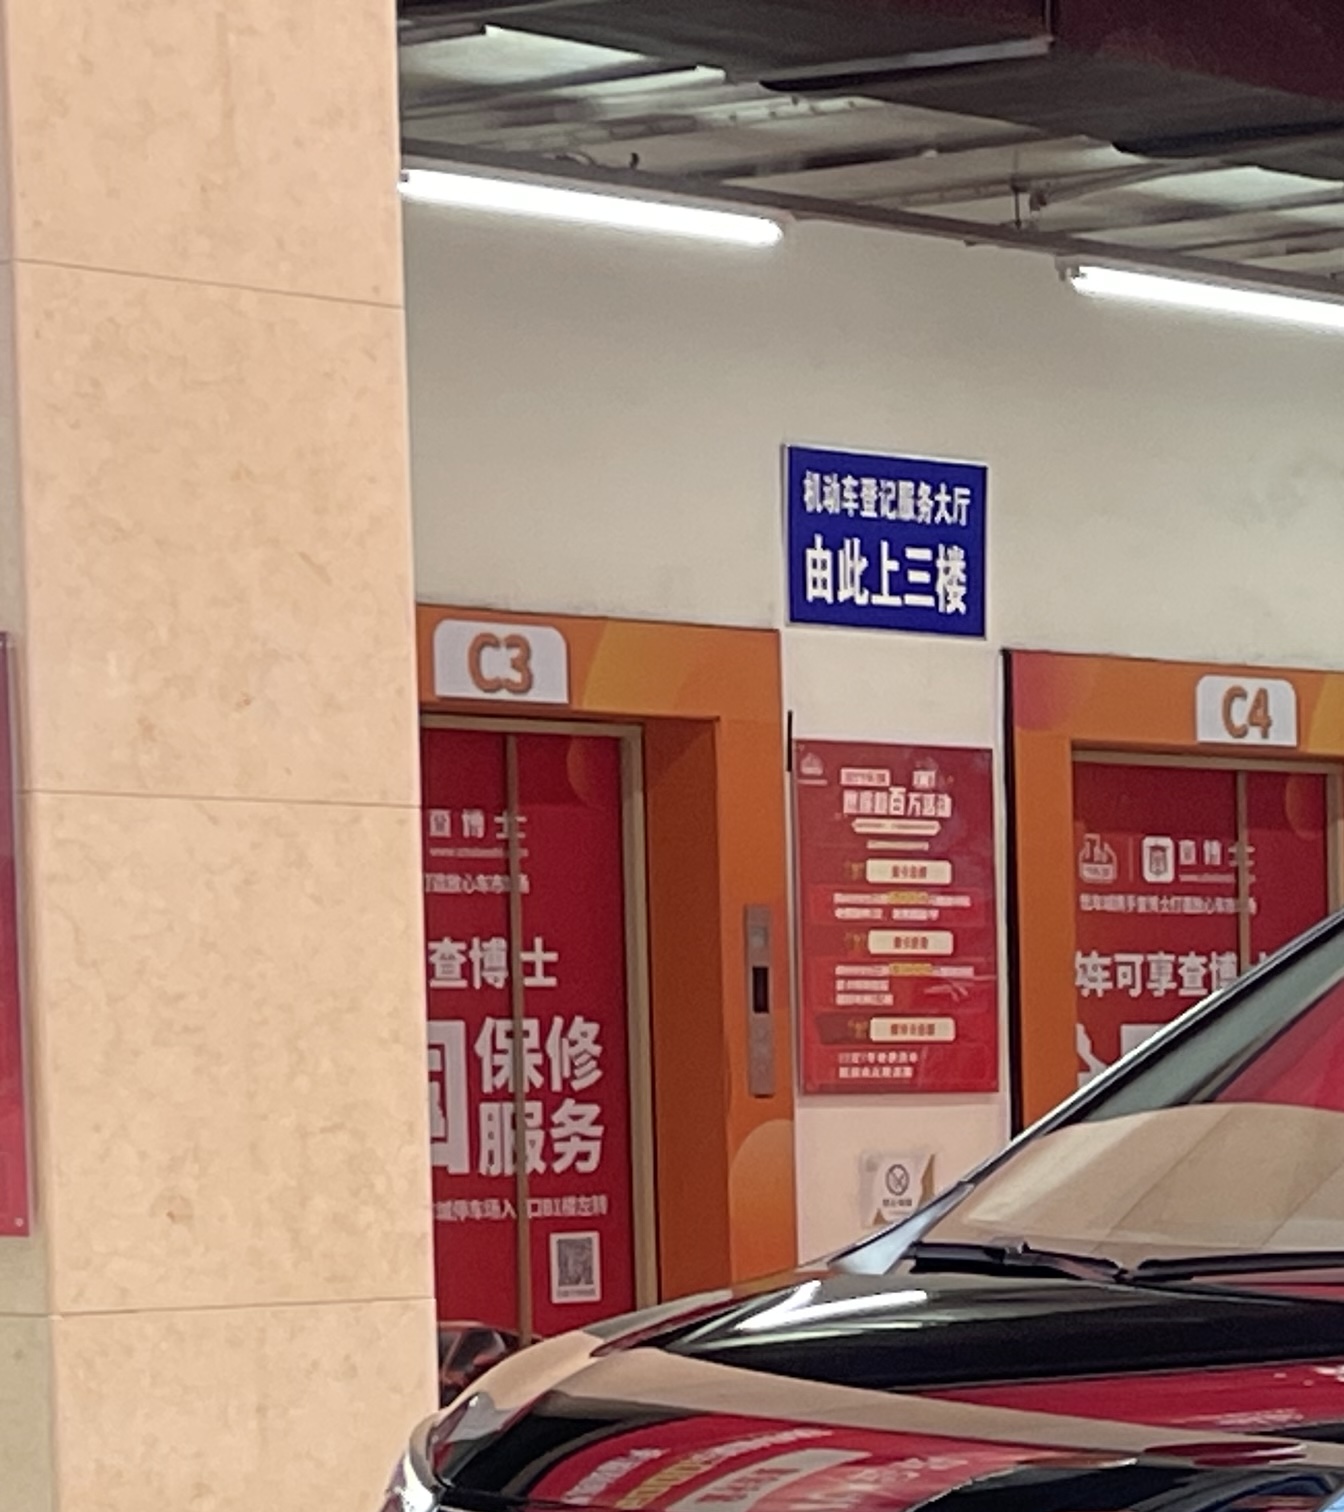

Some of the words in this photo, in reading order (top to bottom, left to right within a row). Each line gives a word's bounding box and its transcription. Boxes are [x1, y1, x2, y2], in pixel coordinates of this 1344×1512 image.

[803, 469, 971, 527] 机动车登记服务大厅
[804, 533, 967, 615] 由此上三楼
[467, 632, 533, 694] C3
[1221, 685, 1273, 740] C4
[427, 936, 559, 990] 查博士
[474, 1015, 604, 1094] 保修
[478, 1098, 604, 1176] 服务
